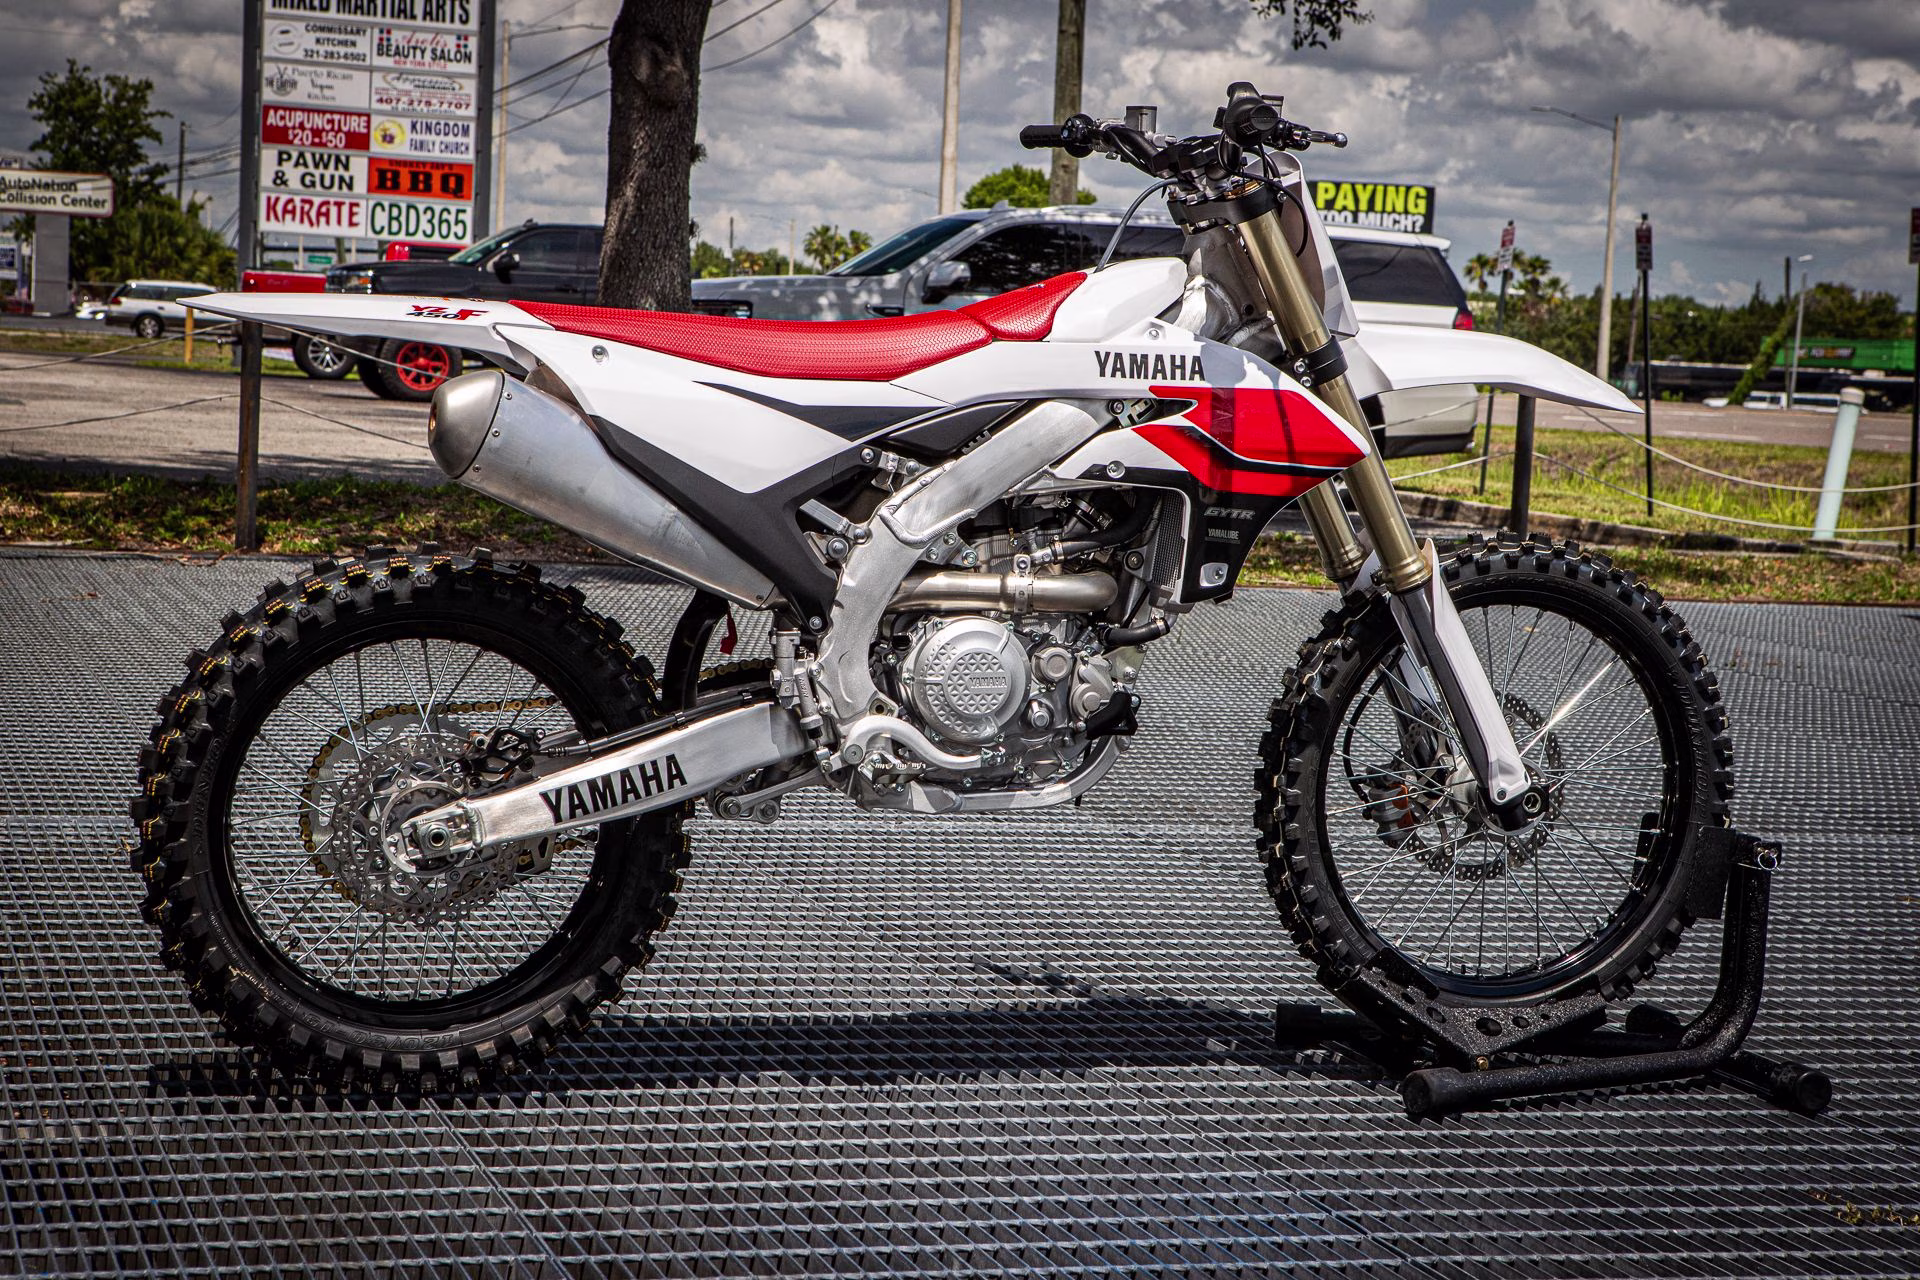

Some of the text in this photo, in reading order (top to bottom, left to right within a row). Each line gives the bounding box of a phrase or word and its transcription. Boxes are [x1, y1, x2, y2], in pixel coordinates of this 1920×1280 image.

[336, 0, 417, 20] MARTIAL
[421, 0, 470, 25] ARTS
[304, 23, 367, 36] COMMISSARY
[315, 37, 357, 48] KITCHEN
[376, 43, 472, 64] BEAUTY SALON
[266, 109, 368, 133] ACUPUNCTURE
[410, 119, 470, 138] KINGDOM
[409, 138, 470, 155] FAMILY CHURCH
[277, 151, 351, 171] PAWN
[0, 176, 78, 192] AutoNation
[272, 169, 354, 191] & GUN
[376, 167, 465, 199] BBQ
[60, 194, 108, 208] Center
[1316, 181, 1427, 215] PAYING
[265, 195, 361, 229] KARATE
[370, 202, 467, 240] CBD365
[1319, 210, 1425, 233] TOO MUCH?
[1094, 350, 1206, 381] YAMAHA
[1203, 506, 1256, 520] GYTR
[1207, 528, 1240, 540] YAMALUBE
[968, 676, 1008, 689] YAMAHA
[538, 753, 688, 826] YAMAHA
